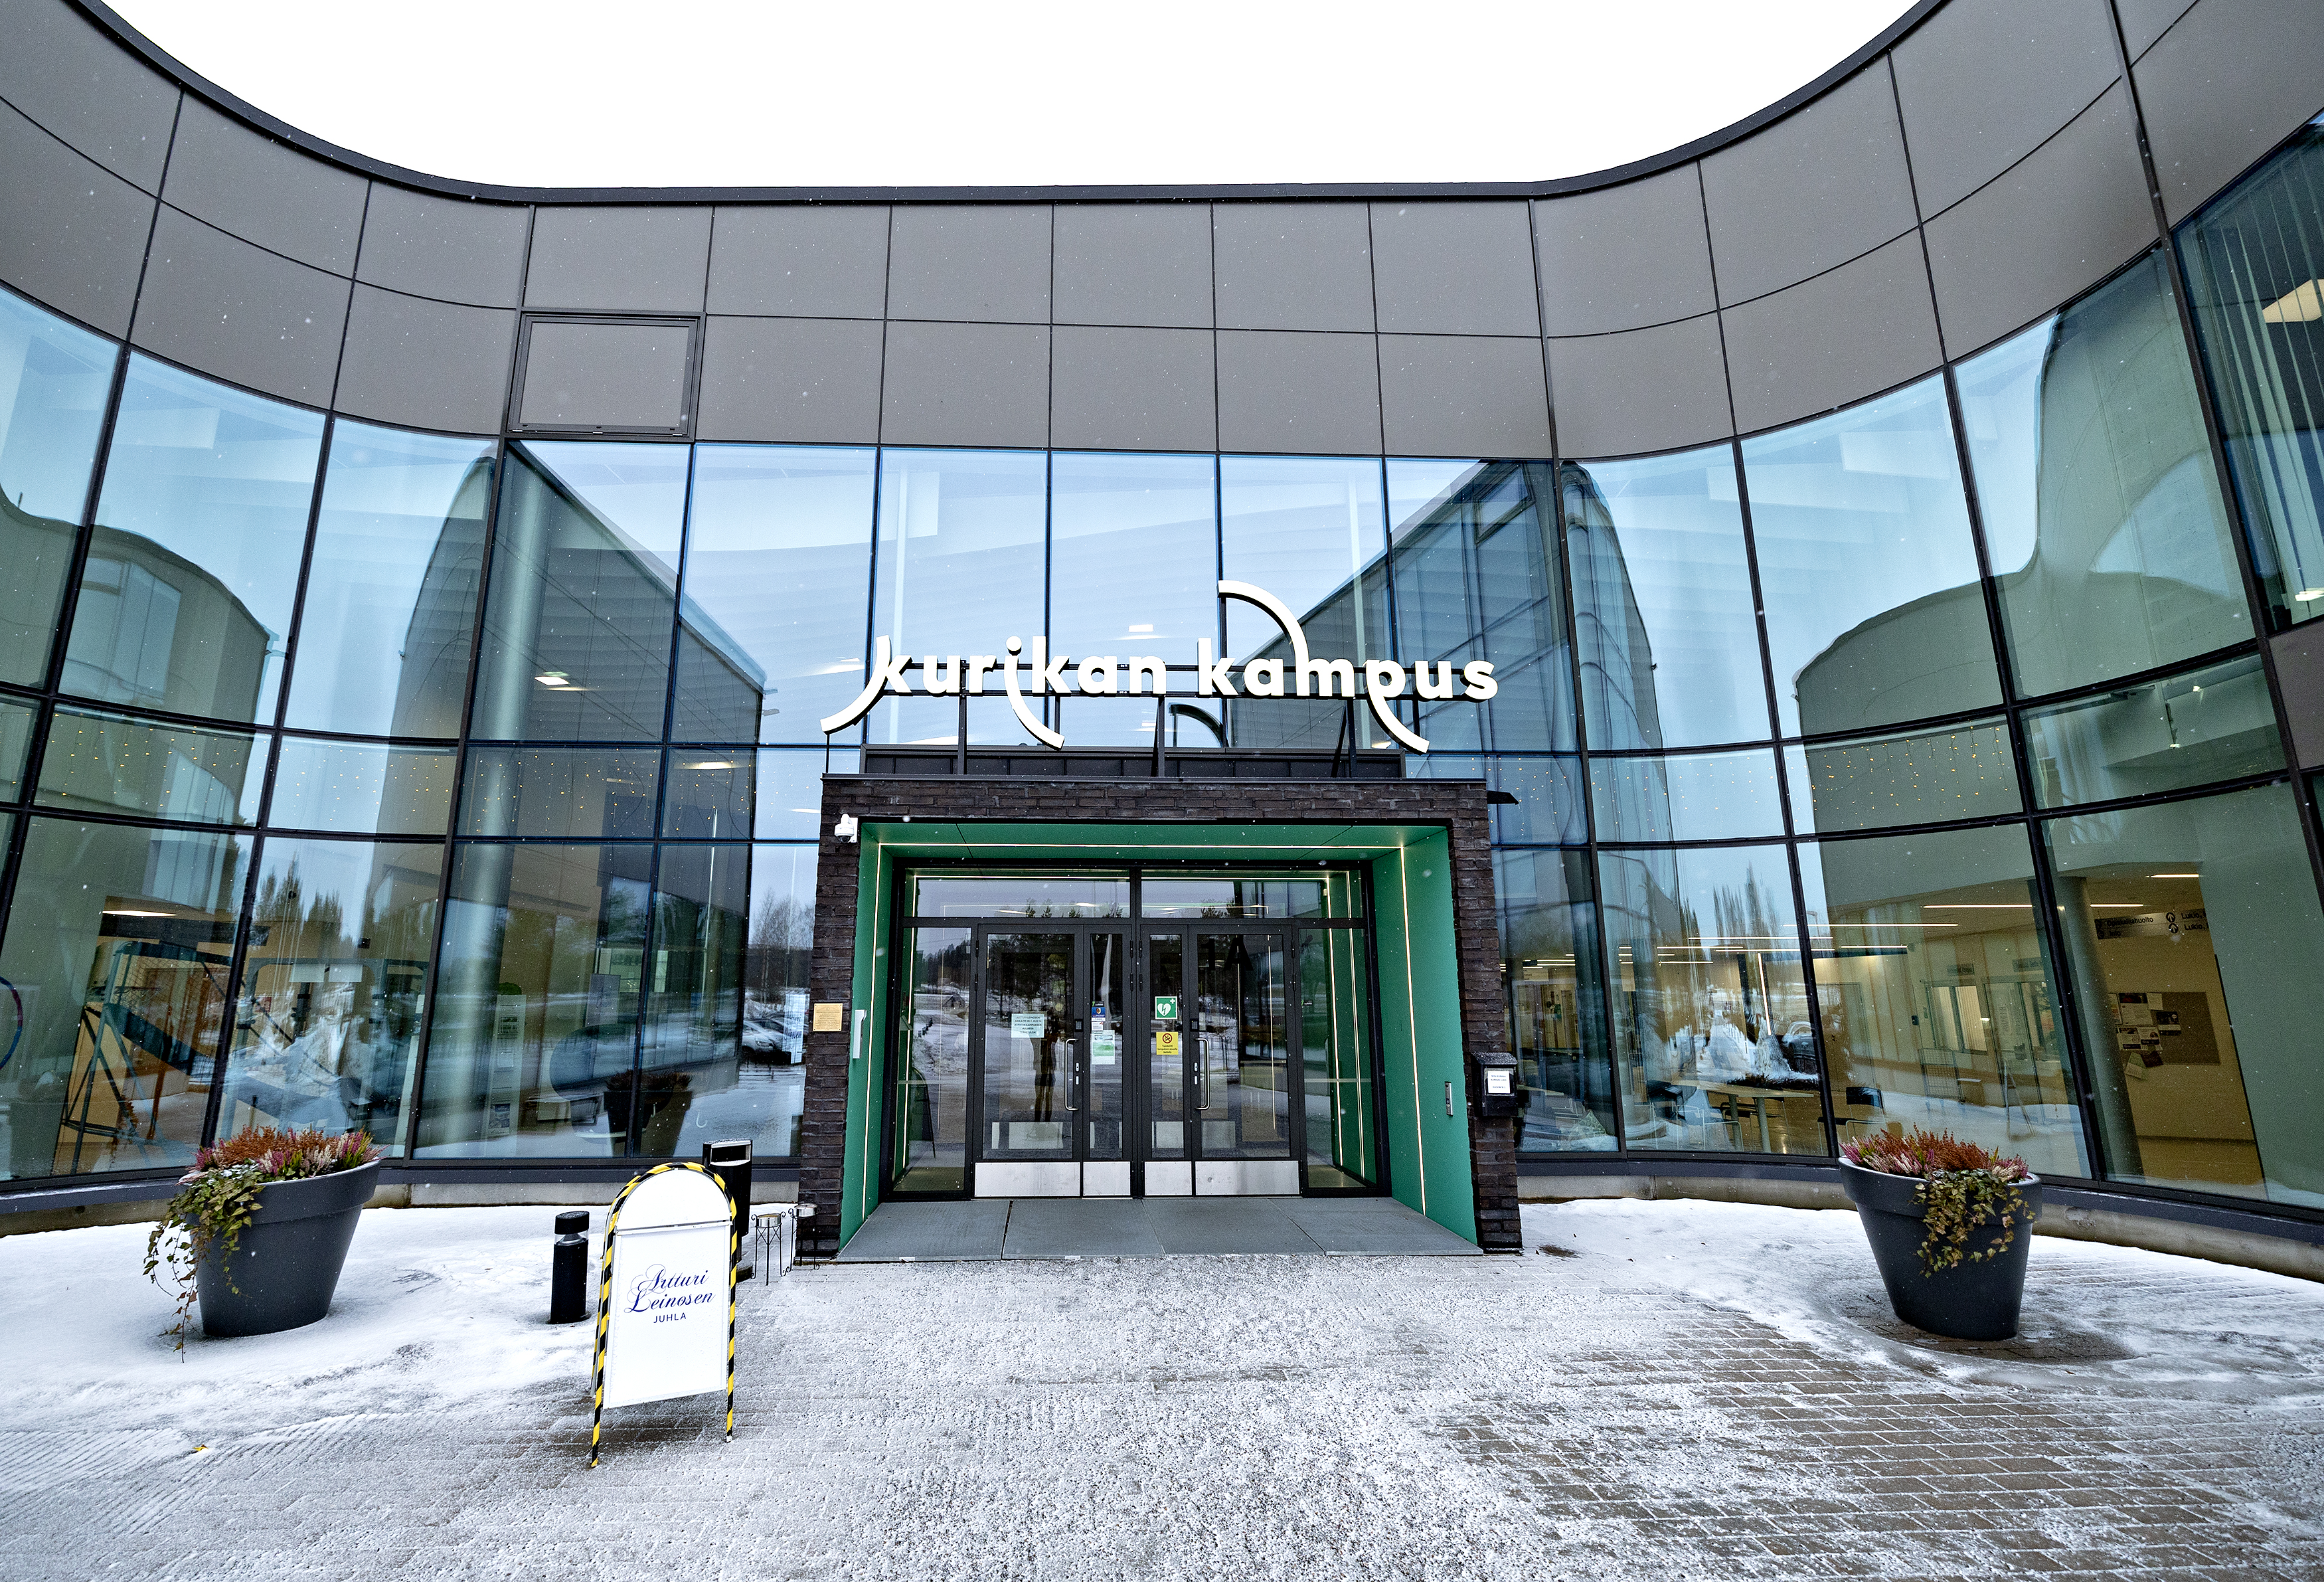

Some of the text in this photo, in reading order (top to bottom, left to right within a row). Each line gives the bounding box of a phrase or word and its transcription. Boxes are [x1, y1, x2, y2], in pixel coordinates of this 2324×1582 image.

[819, 579, 1498, 754] kurikan kampus
[1201, 938, 1254, 970] 1A
[630, 1263, 710, 1296] Artturi
[623, 1287, 716, 1313] Leinosen
[653, 1312, 687, 1324] JUHLA
